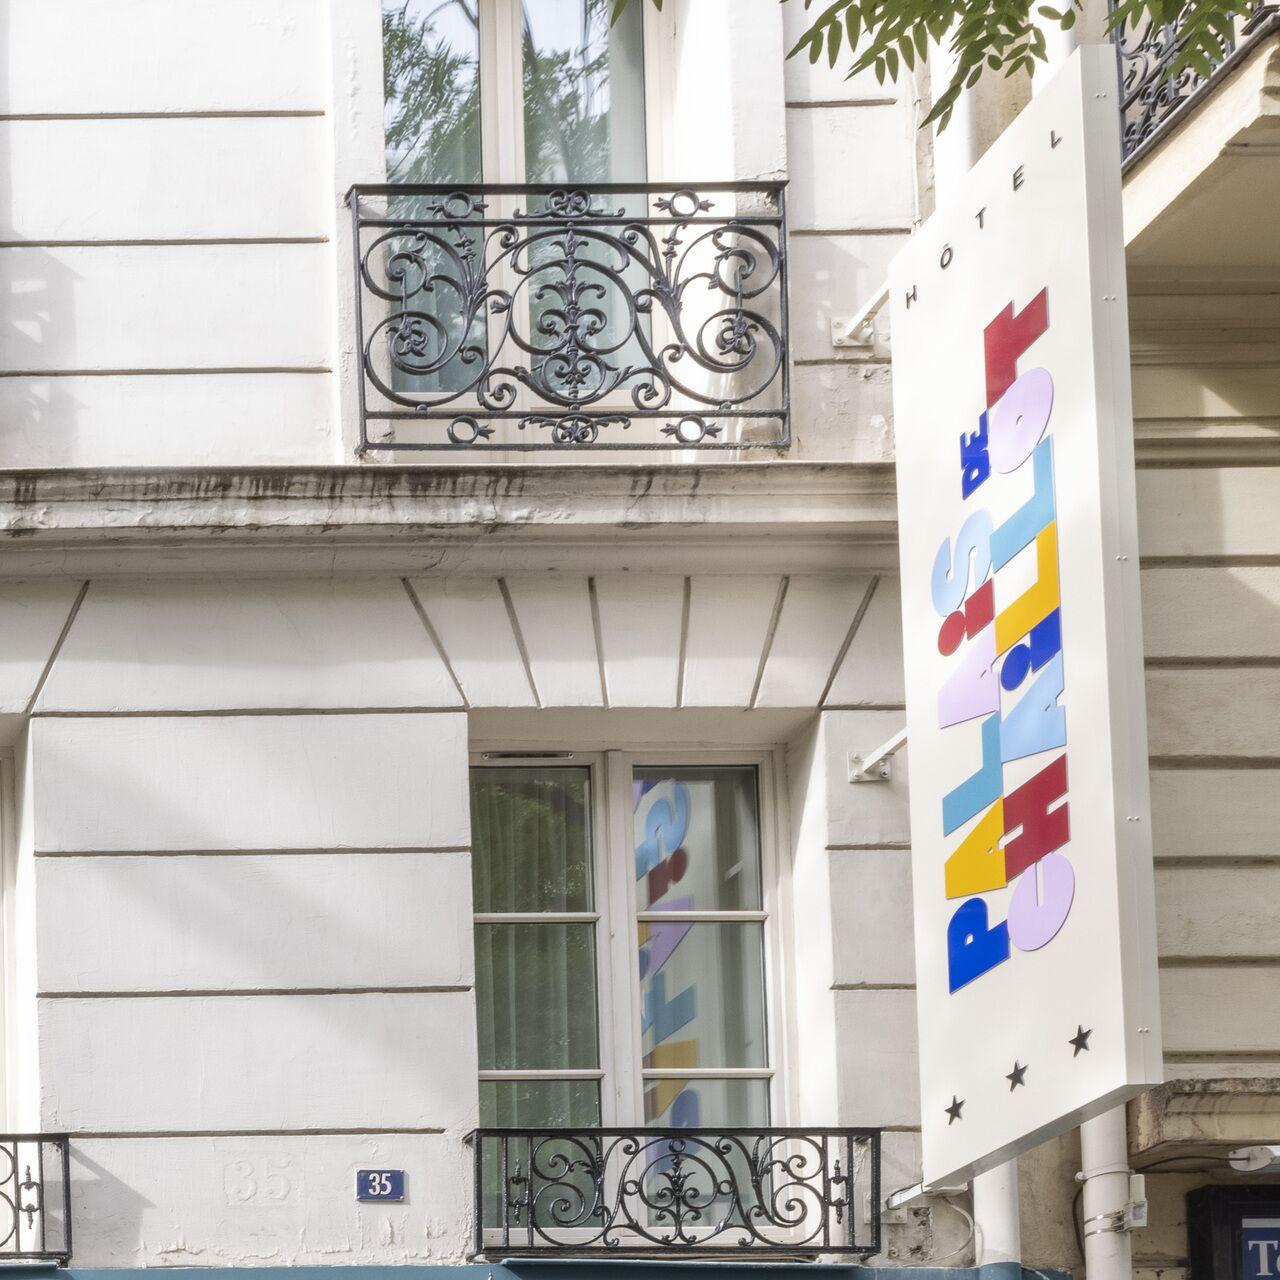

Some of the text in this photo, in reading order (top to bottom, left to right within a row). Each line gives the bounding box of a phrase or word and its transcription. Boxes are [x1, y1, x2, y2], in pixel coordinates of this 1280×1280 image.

[905, 129, 1063, 309] HÔTEL
[959, 409, 992, 501] DE
[368, 1173, 392, 1196] 35
